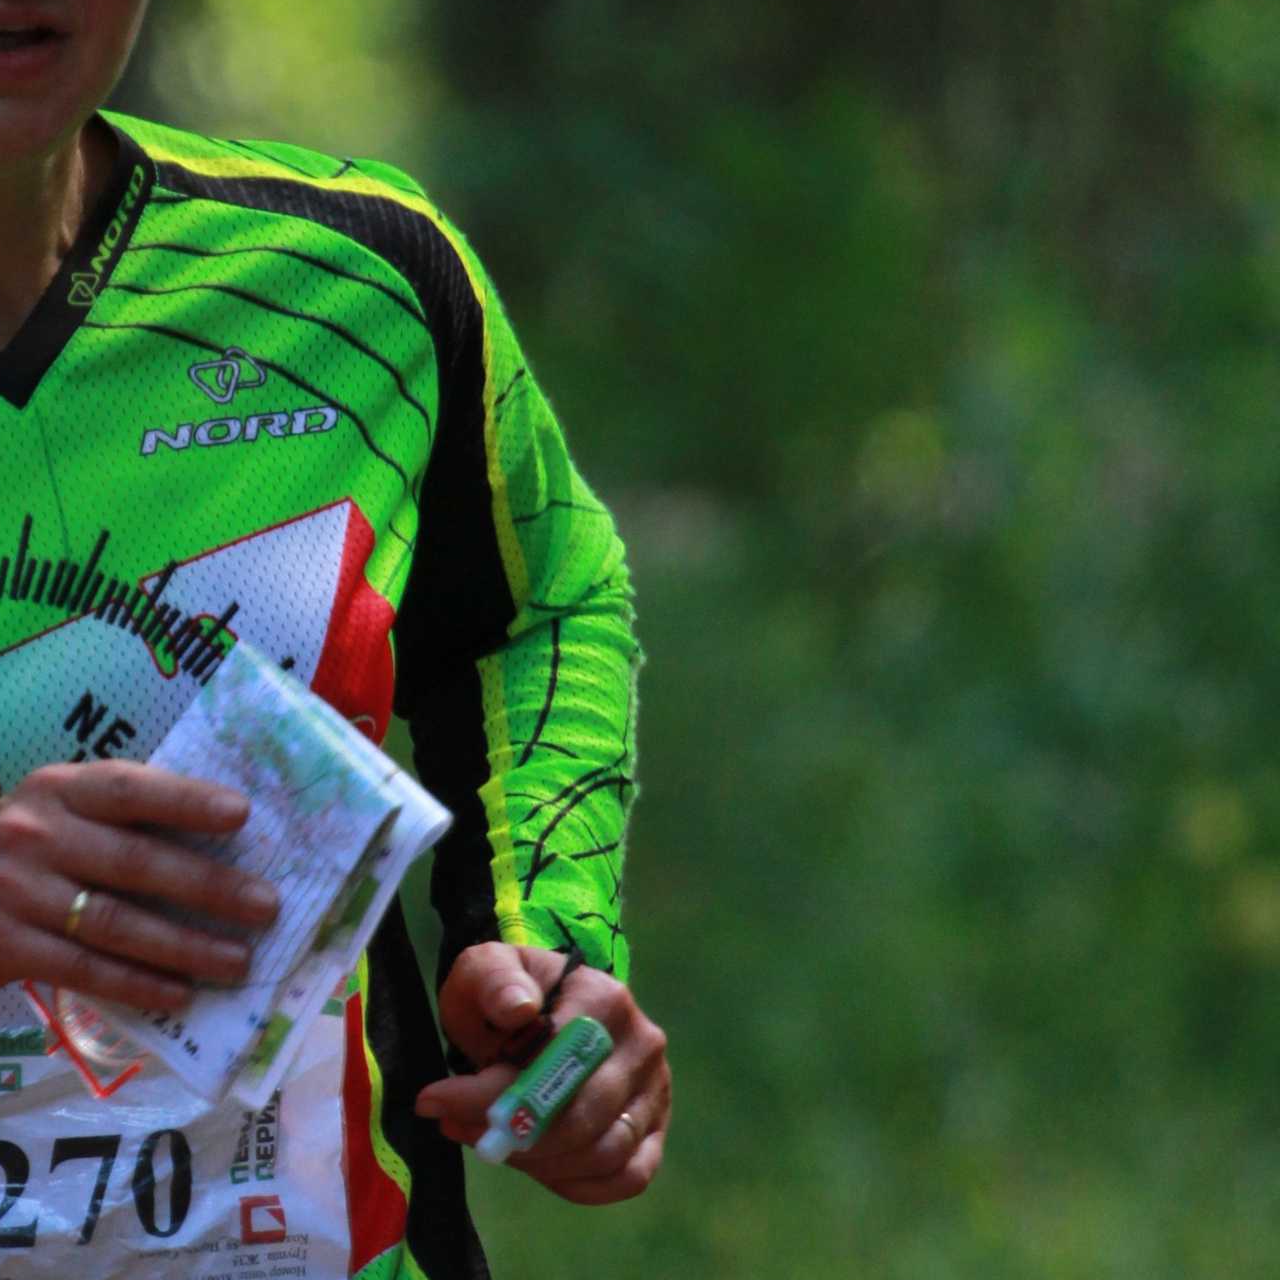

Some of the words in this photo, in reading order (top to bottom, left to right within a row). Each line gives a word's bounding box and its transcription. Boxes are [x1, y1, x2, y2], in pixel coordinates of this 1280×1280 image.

[90, 165, 145, 272] NORD
[140, 406, 339, 456] NORD
[63, 692, 137, 760] NE
